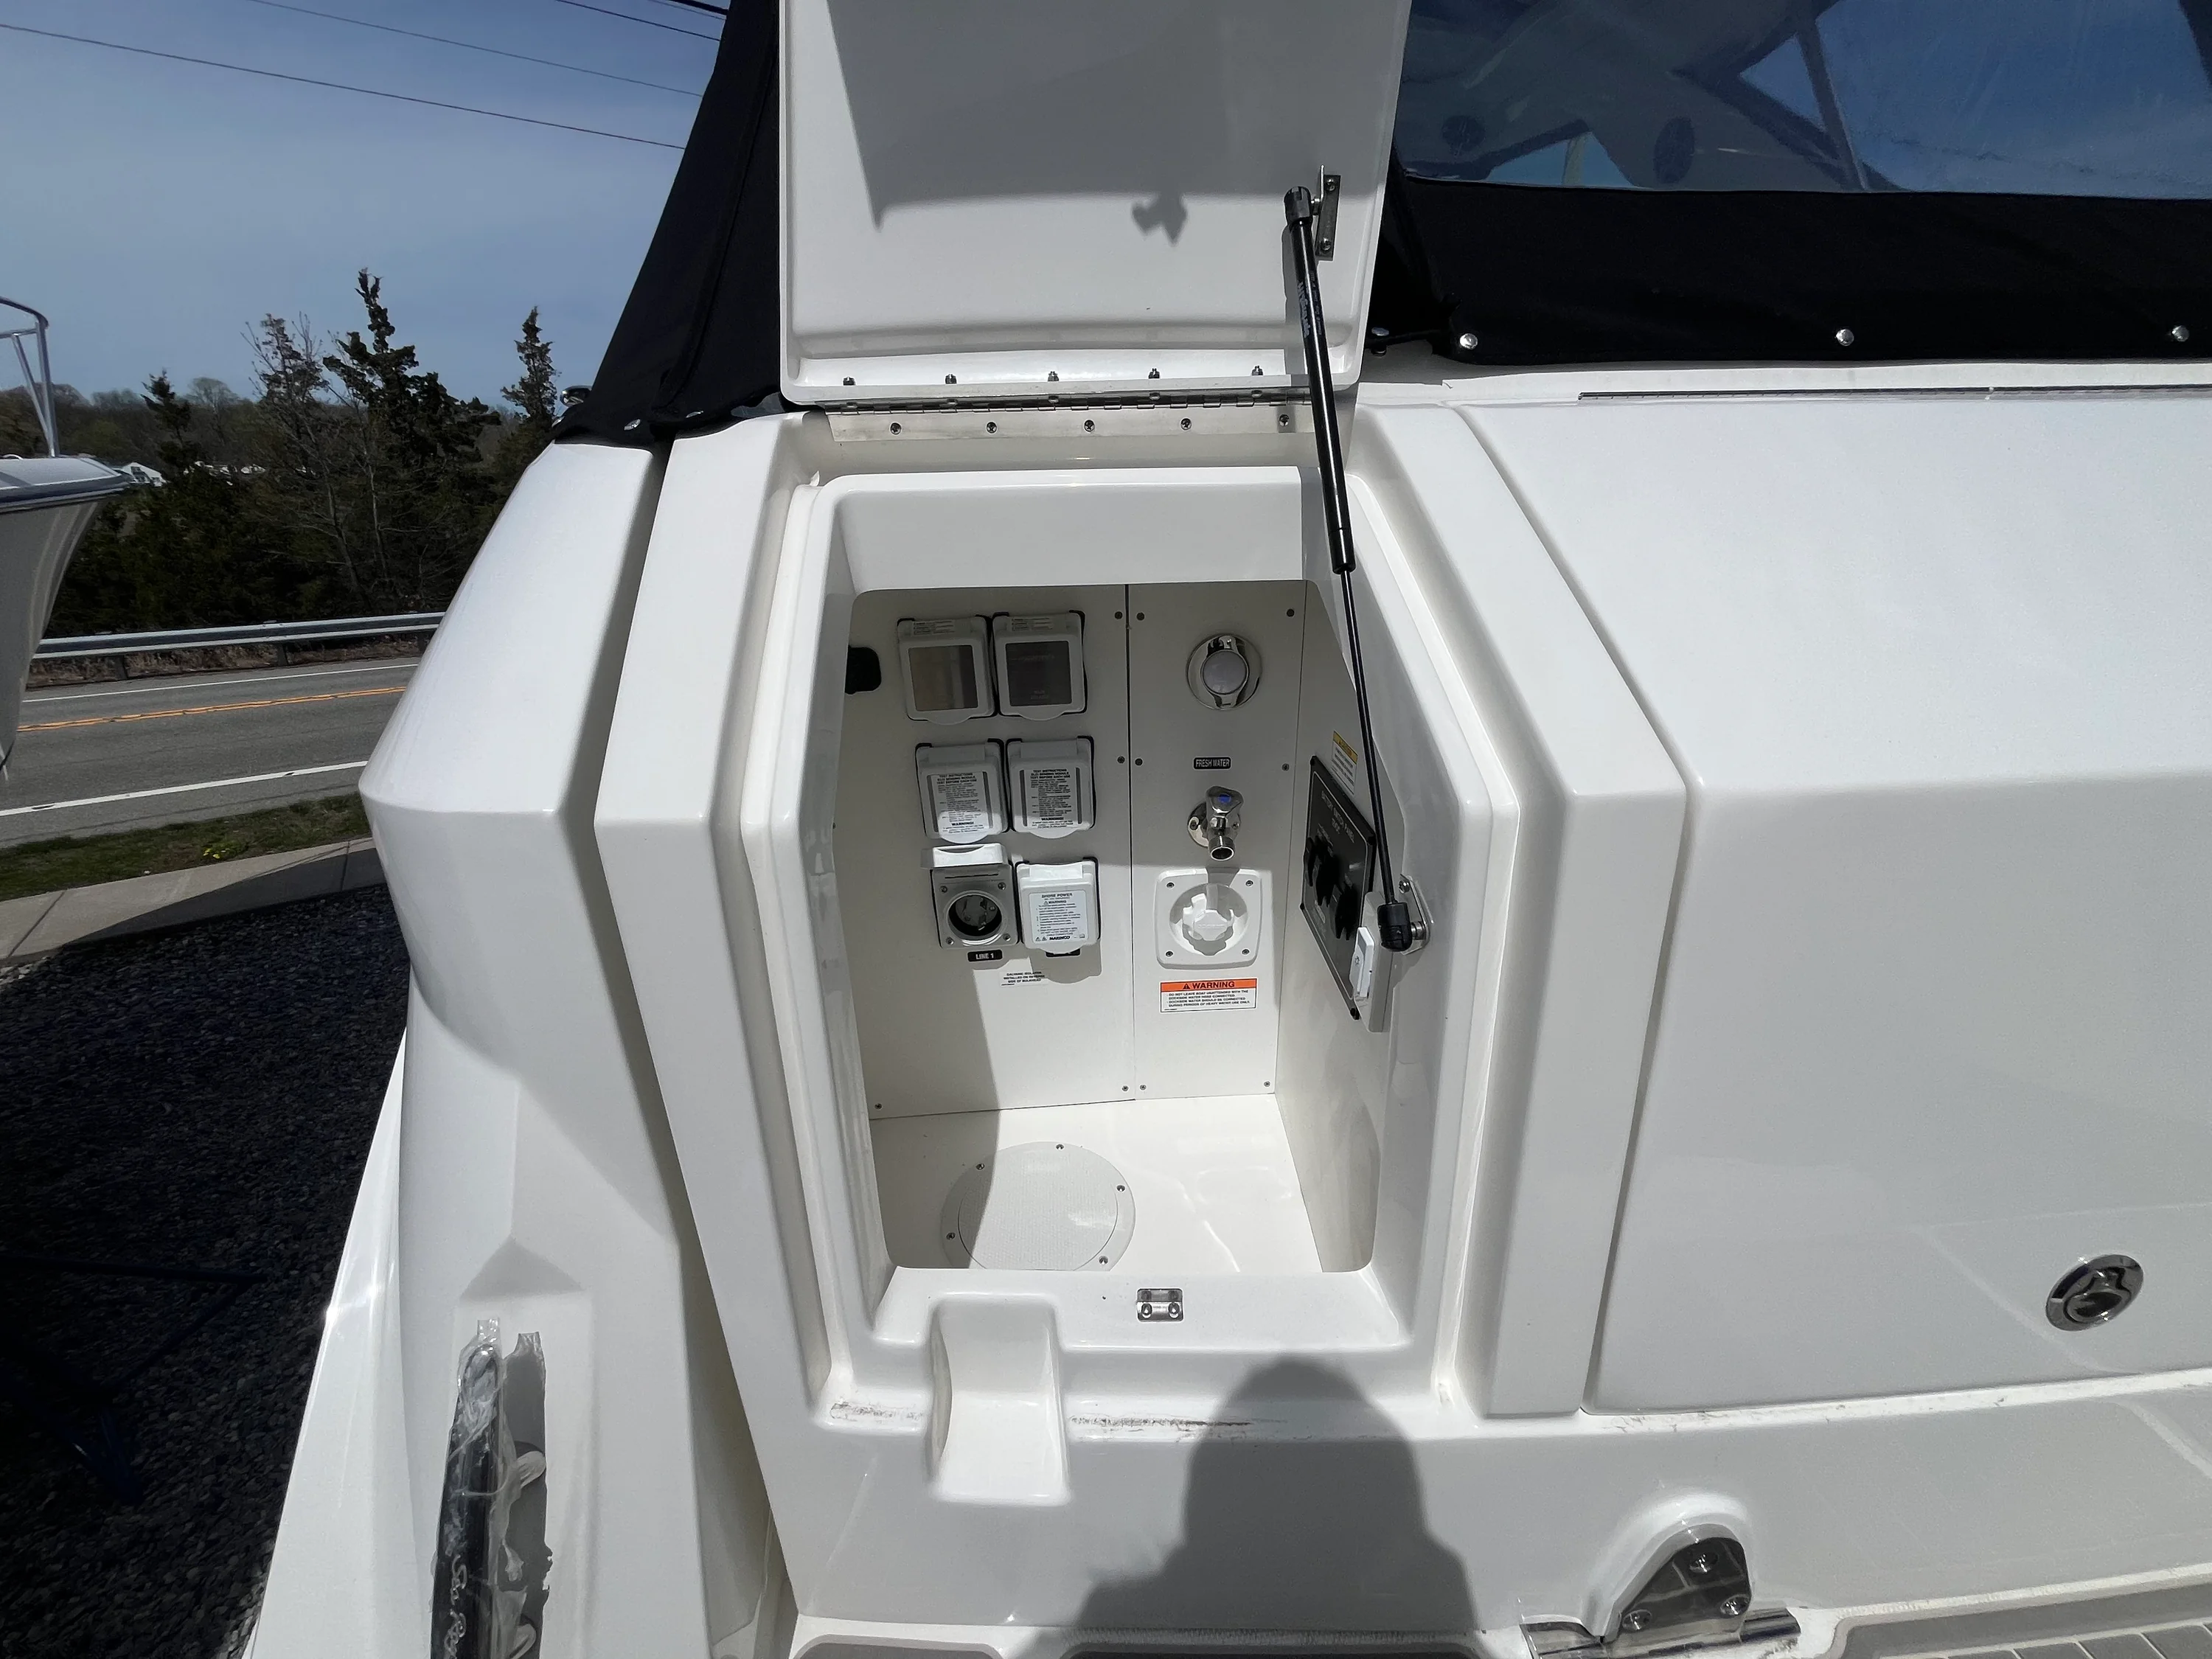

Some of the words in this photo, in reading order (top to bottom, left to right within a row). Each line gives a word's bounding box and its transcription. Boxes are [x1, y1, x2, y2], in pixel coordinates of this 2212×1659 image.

[1195, 759, 1212, 768] FRESH
[1212, 759, 1230, 767] WATER
[1192, 981, 1235, 989] WARNING
